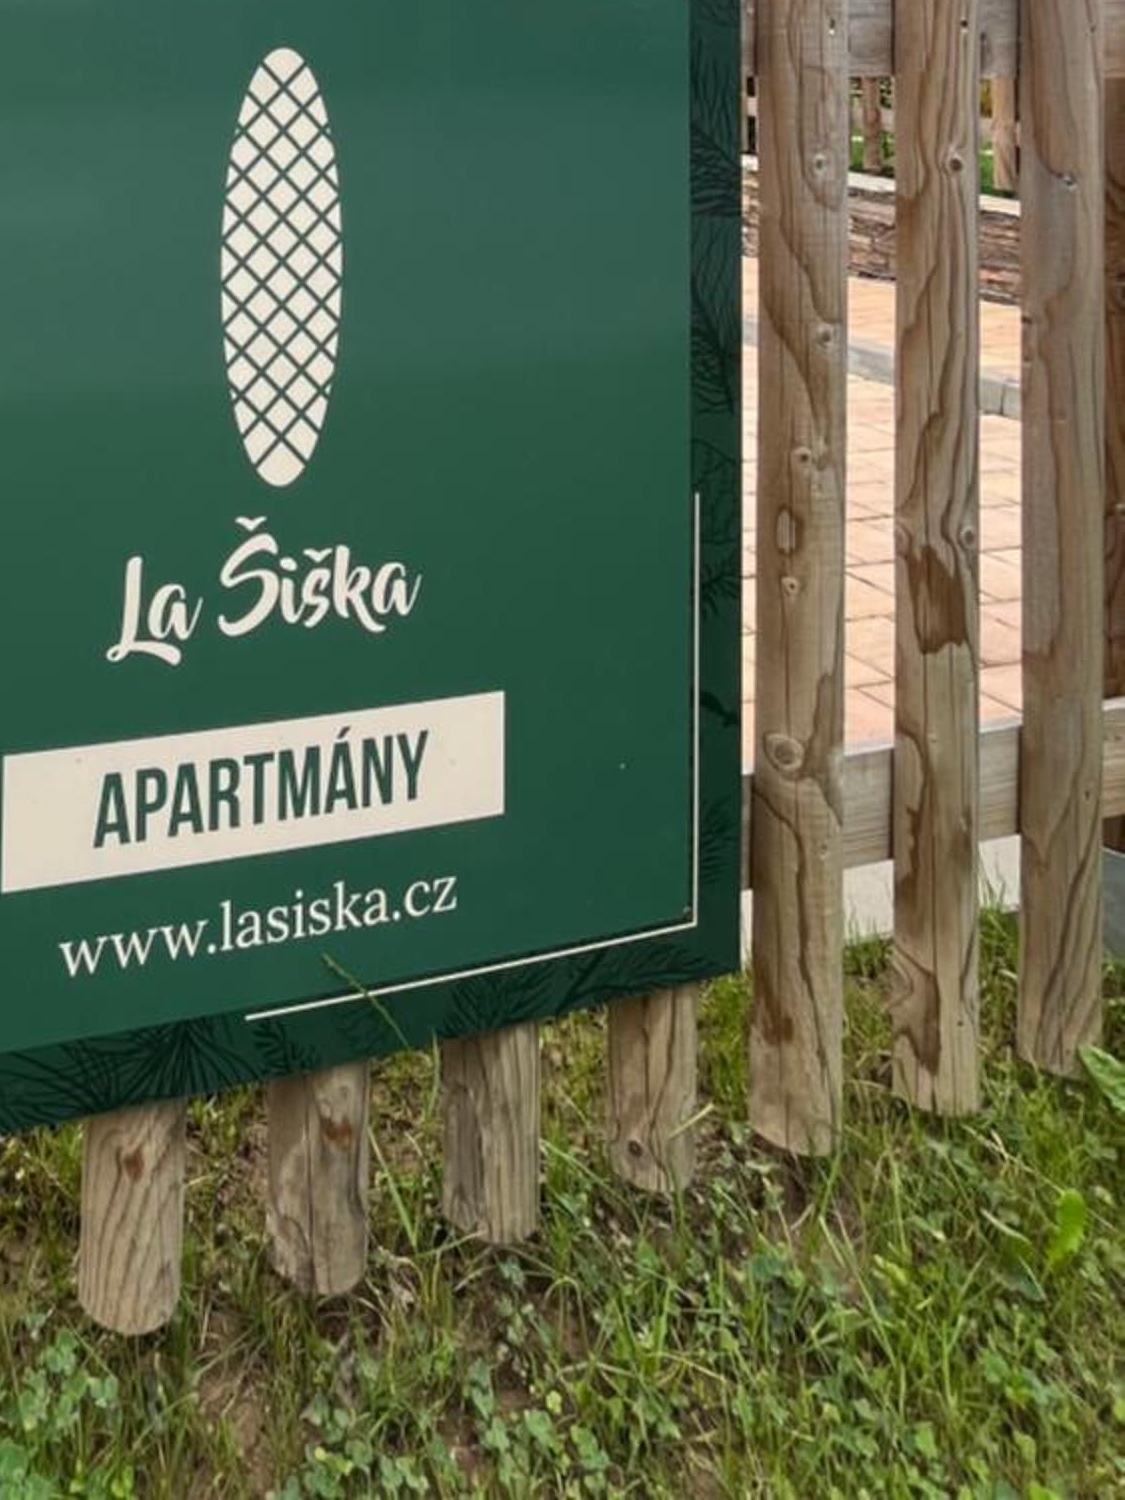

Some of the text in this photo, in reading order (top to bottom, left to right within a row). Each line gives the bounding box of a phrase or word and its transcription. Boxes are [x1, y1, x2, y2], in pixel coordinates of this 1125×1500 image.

[106, 516, 423, 667] La Šiška
[93, 726, 429, 849] APARTMÁNY
[59, 875, 458, 978] www.lasiska.cz
